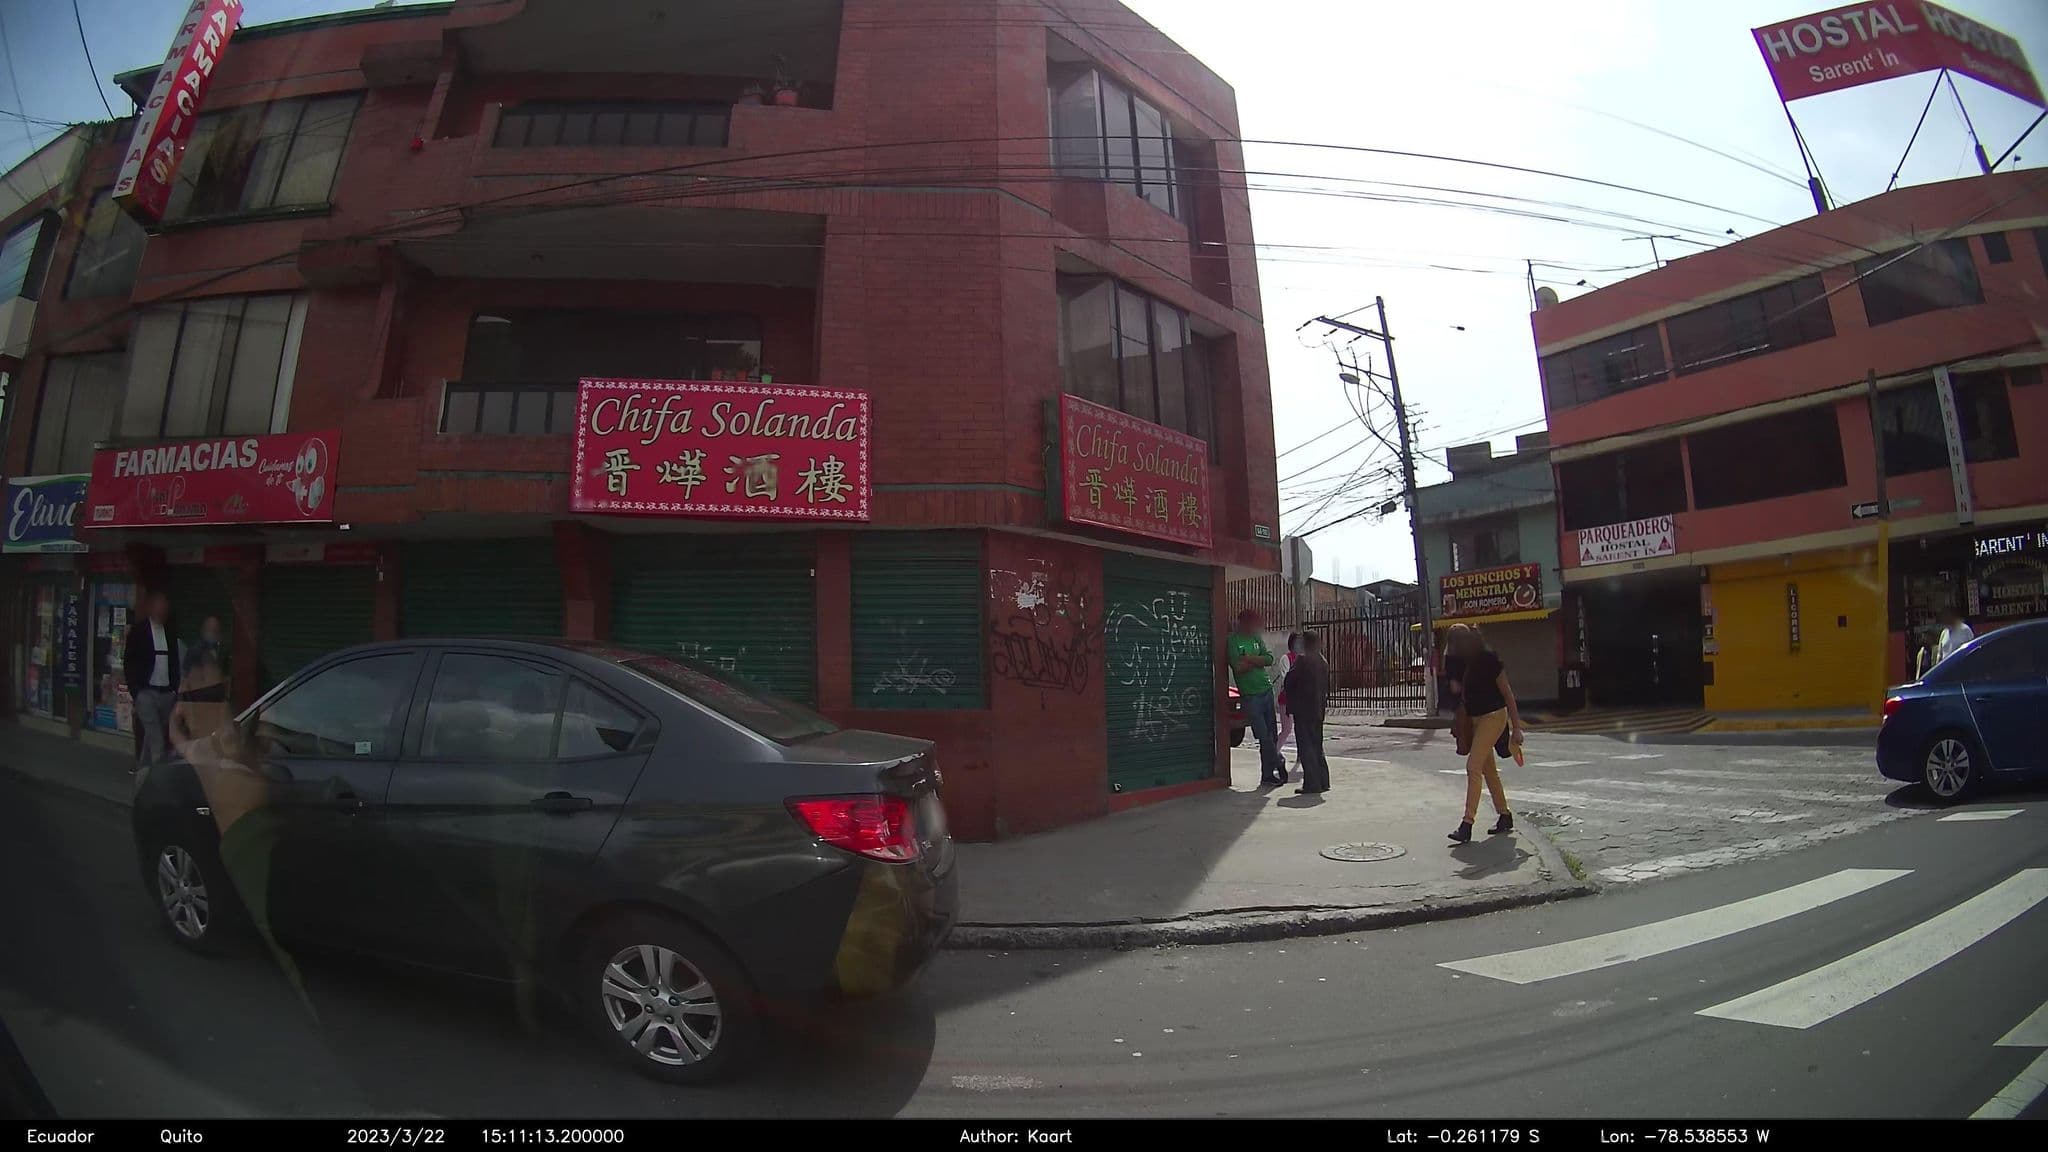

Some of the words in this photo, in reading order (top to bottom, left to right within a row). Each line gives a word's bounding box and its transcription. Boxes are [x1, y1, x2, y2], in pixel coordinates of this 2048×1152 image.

[1764, 4, 1918, 62] HOSTAL
[590, 393, 692, 445] Chifa
[702, 398, 858, 440] Solanda
[113, 438, 259, 477] FARMACIAS
[1076, 424, 1129, 472] Chifa
[1132, 441, 1199, 486] Solanda
[1580, 517, 1670, 545] PARQUEADERO
[1595, 550, 1637, 562] SARENT
[1601, 539, 1646, 552] HOSTAL
[1443, 576, 1465, 589] LOS
[1467, 568, 1521, 586] PINCHOS
[1523, 565, 1533, 578] Y
[1456, 582, 1516, 600] MENESTRAS
[1480, 596, 1508, 608] ROMERO
